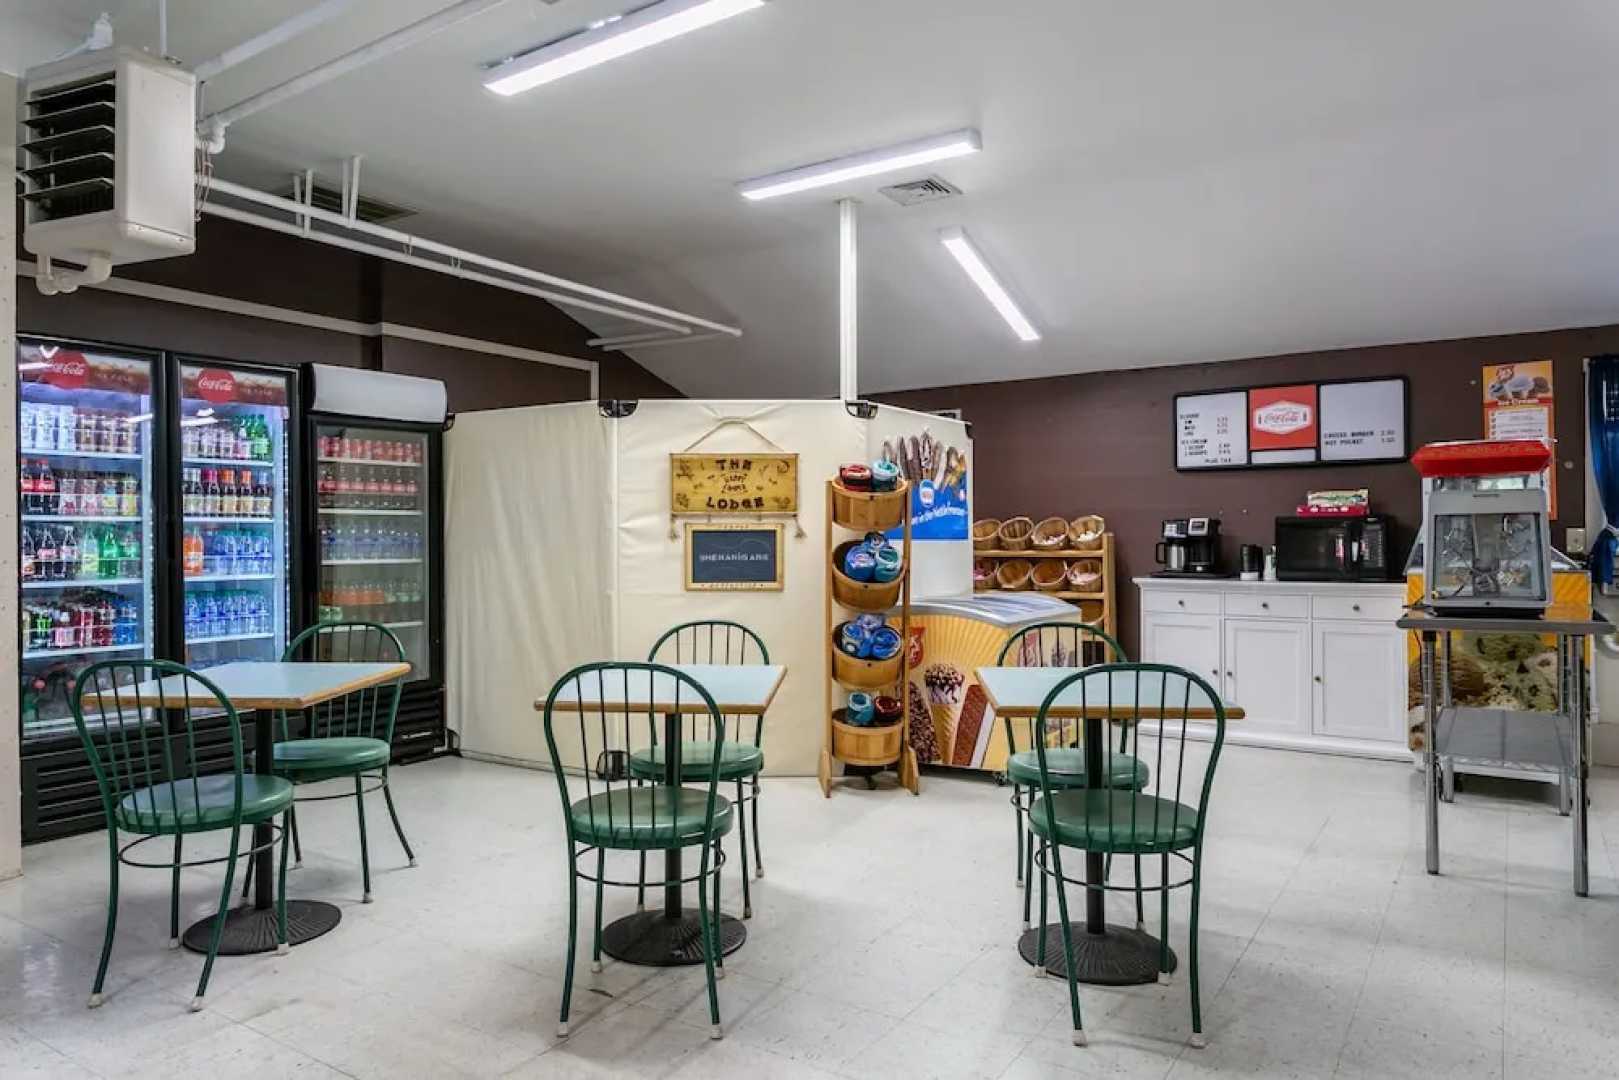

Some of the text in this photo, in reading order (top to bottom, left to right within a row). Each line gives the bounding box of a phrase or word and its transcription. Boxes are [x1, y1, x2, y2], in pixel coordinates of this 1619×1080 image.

[715, 459, 752, 471] THE
[707, 496, 764, 510] LODGE
[699, 551, 769, 562] SHENANIGANS
